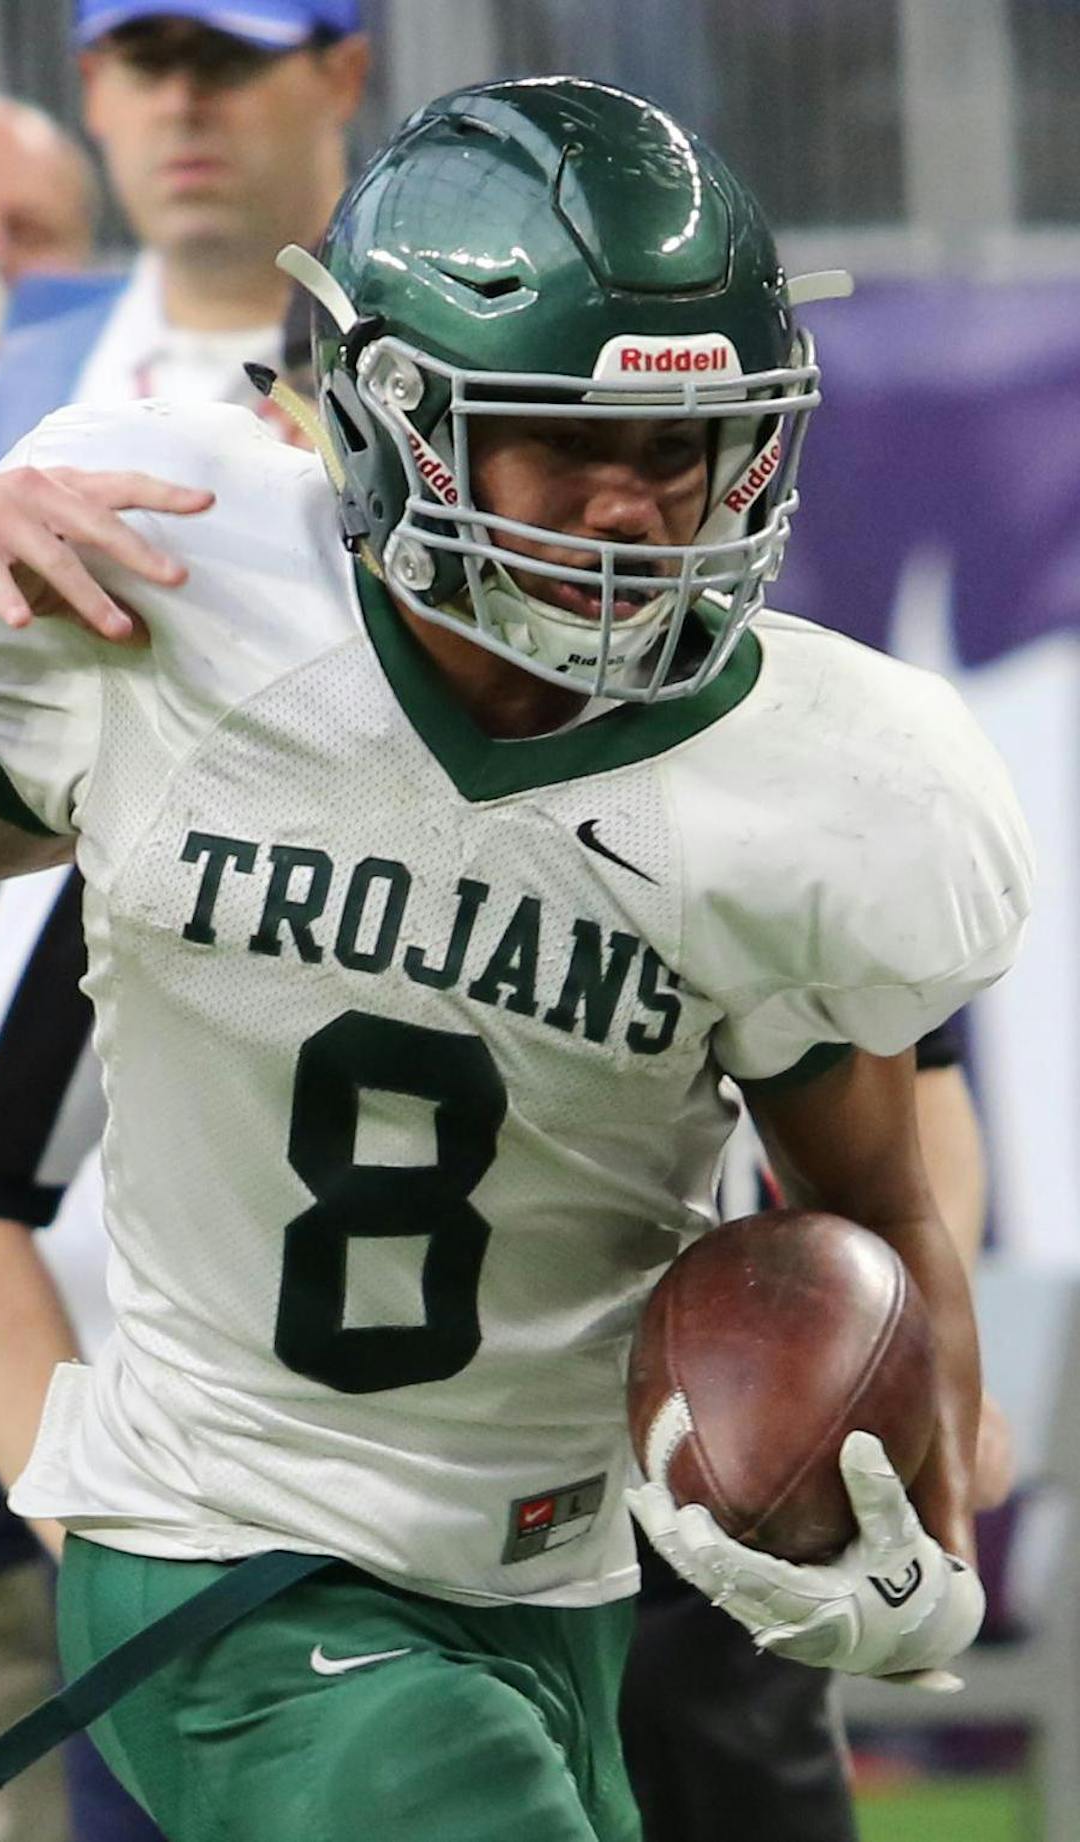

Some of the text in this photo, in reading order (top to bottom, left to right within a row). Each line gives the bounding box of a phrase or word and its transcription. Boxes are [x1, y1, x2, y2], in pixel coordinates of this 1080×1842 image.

[621, 347, 727, 372] Riddell
[408, 432, 458, 505] Ridde
[179, 830, 683, 1056] TROJANS
[273, 1009, 508, 1395] 8
